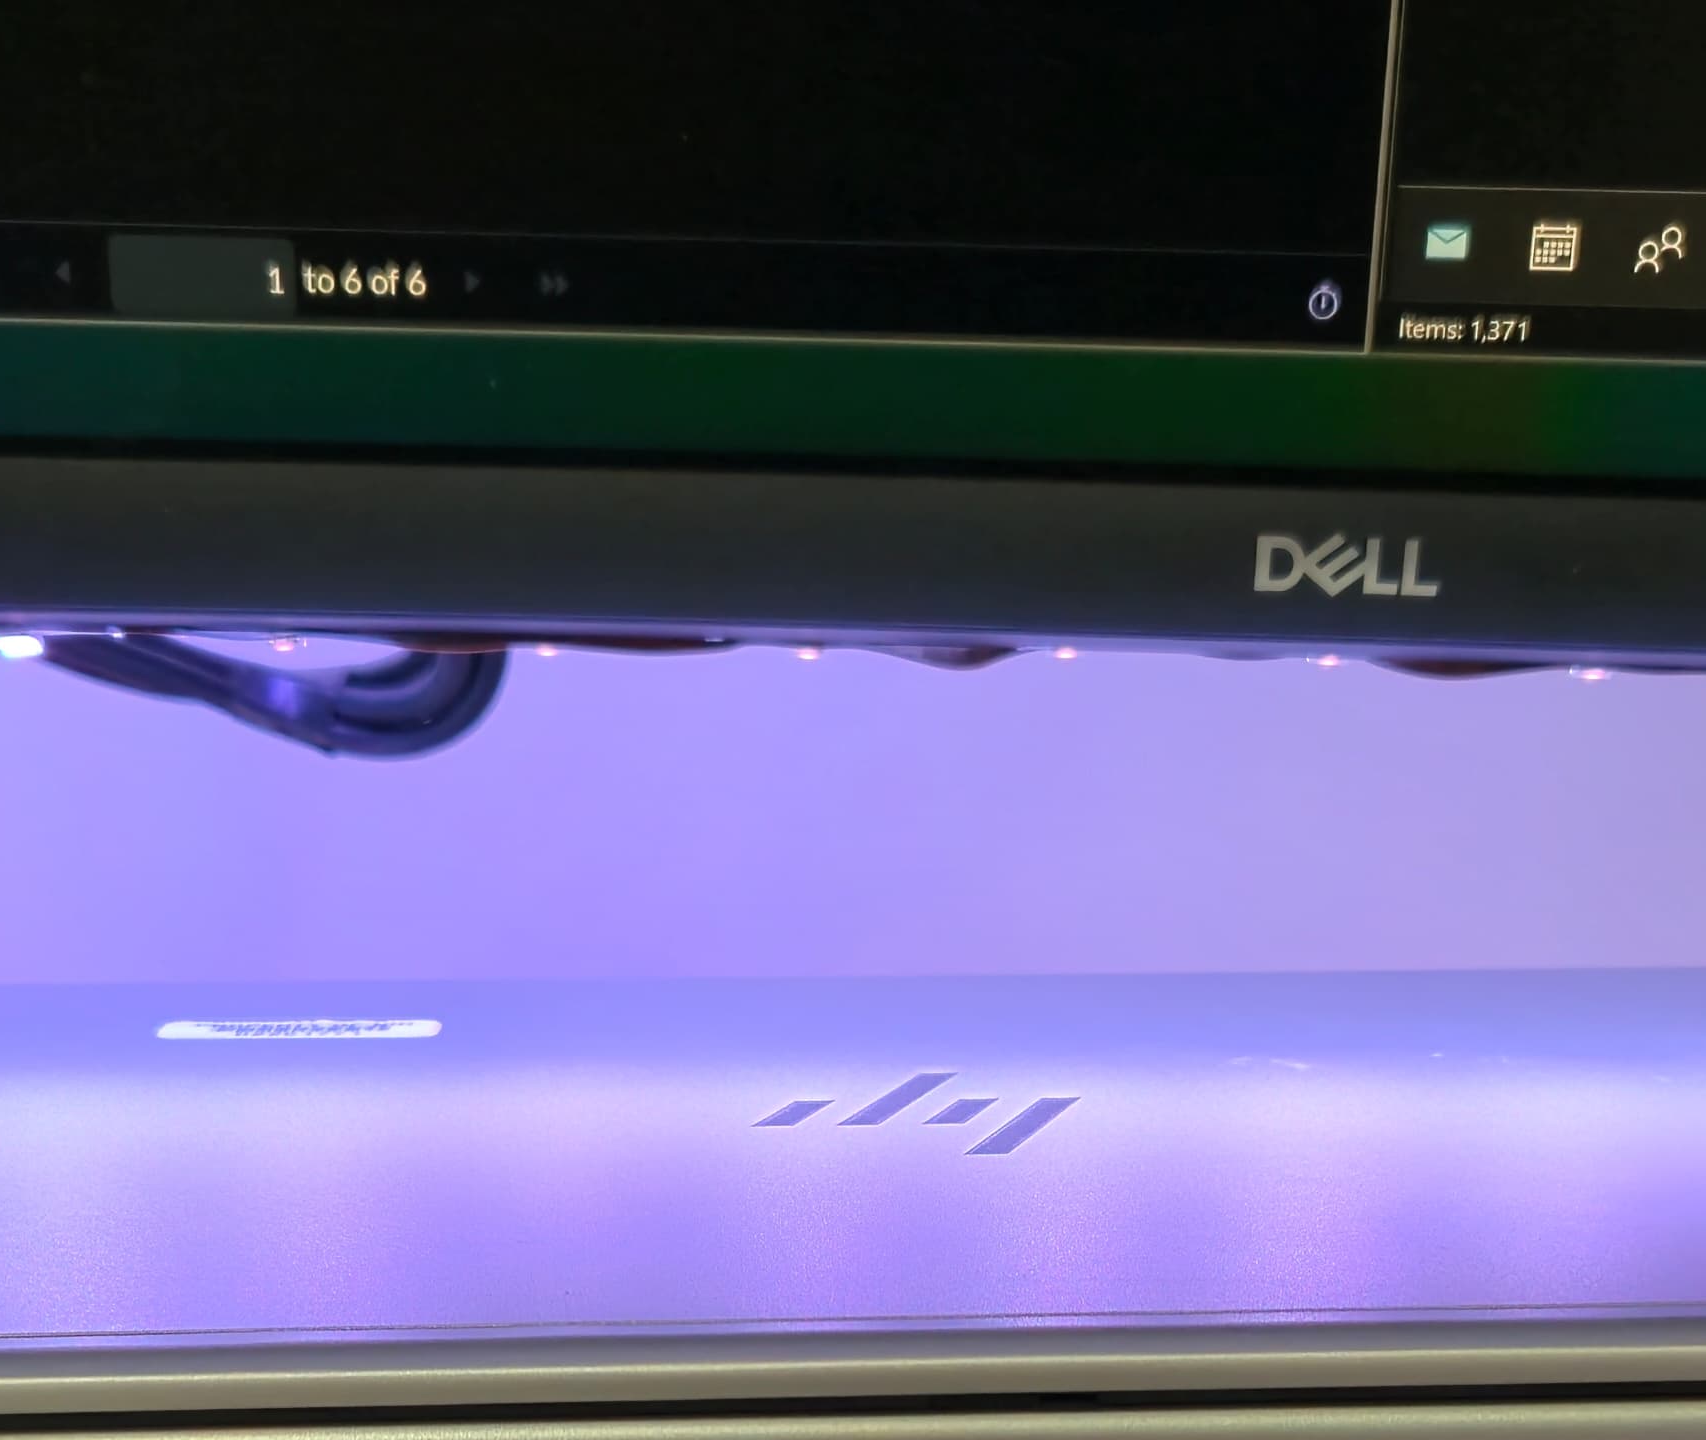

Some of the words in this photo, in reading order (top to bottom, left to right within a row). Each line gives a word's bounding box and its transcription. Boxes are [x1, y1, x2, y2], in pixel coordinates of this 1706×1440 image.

[269, 266, 285, 294] 1
[303, 266, 335, 294] to
[345, 268, 362, 295] 6
[371, 269, 400, 295] of
[409, 269, 427, 296] 6
[1399, 317, 1462, 340] Items:
[1471, 320, 1527, 344] 1,371
[1253, 533, 1438, 597] DELL
